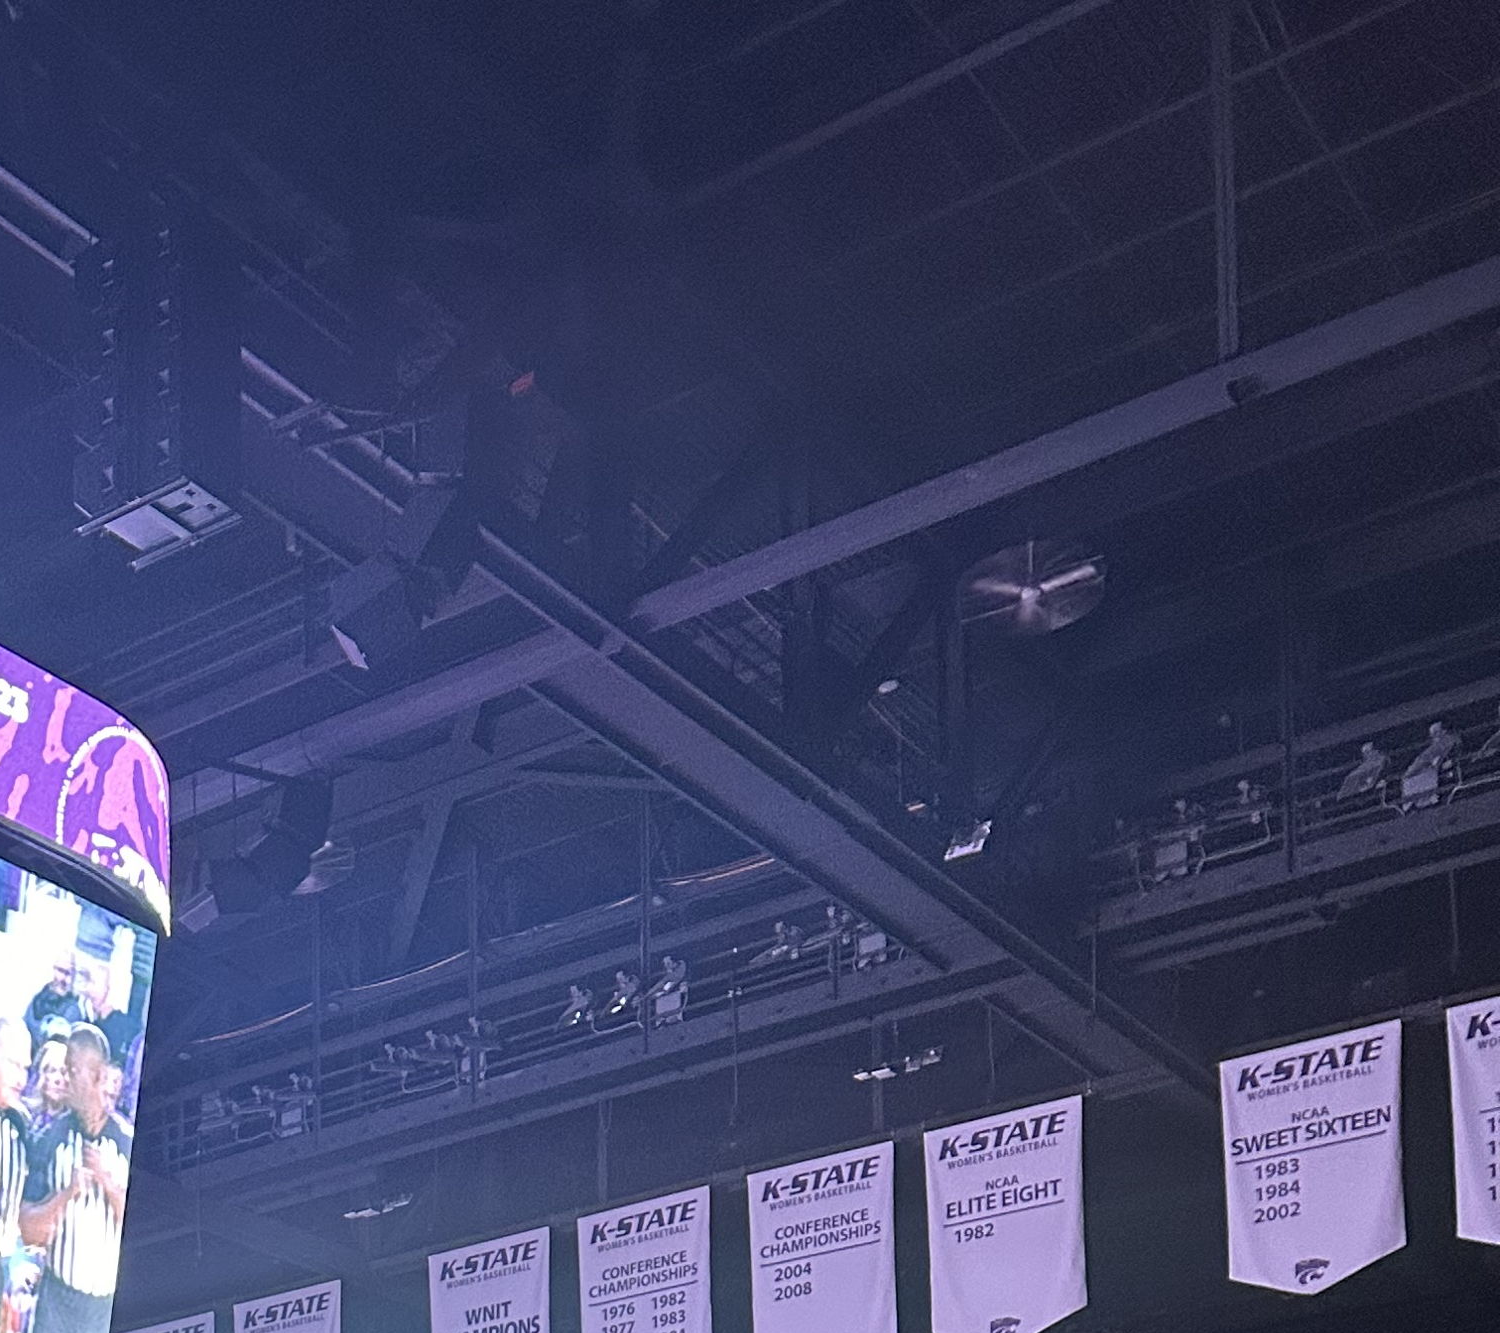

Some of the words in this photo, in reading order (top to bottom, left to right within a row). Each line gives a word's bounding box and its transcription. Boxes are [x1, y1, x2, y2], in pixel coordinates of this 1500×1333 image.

[1237, 1036, 1385, 1092] K-STATE
[1247, 1080, 1300, 1101] WOMEN'S
[1302, 1066, 1373, 1091] BASKETBALL
[1231, 1125, 1301, 1157] SWEET
[1304, 1105, 1392, 1141] SIXTEEN
[1291, 1106, 1330, 1124] NCAA
[937, 1110, 1068, 1162] K-STATE
[947, 1147, 994, 1170] WOMEN'S
[996, 1136, 1059, 1160] BASKETBALL
[761, 1155, 881, 1203] K-STATE
[985, 1173, 1019, 1191] NCAA
[1254, 1159, 1301, 1180] 1983
[769, 1190, 813, 1212] WOMEN'S
[814, 1179, 873, 1202] BASKETBALL
[945, 1191, 998, 1220] ELITE
[1002, 1178, 1062, 1208] EIGHT
[1254, 1181, 1301, 1202] 1984
[590, 1199, 698, 1245] K-STATE
[774, 1207, 870, 1240] CONFERENCE
[1254, 1202, 1301, 1223] 2002
[637, 1222, 690, 1244] BASKETBALL
[760, 1219, 882, 1260] CHAMPIONSHIPS
[954, 1223, 995, 1245] 1982
[439, 1239, 539, 1282] K-STATE
[483, 1261, 532, 1282] BASKETBALL
[601, 1250, 688, 1280] CONFERENCE
[773, 1261, 813, 1283] 2004
[589, 1261, 698, 1299] CHAMPIONSHIPS
[773, 1281, 813, 1303] 2008
[243, 1291, 331, 1329] K-STATE
[465, 1300, 512, 1326] WNIT
[601, 1301, 636, 1321] 1976
[651, 1290, 686, 1309] 1982
[651, 1309, 686, 1328] 1983
